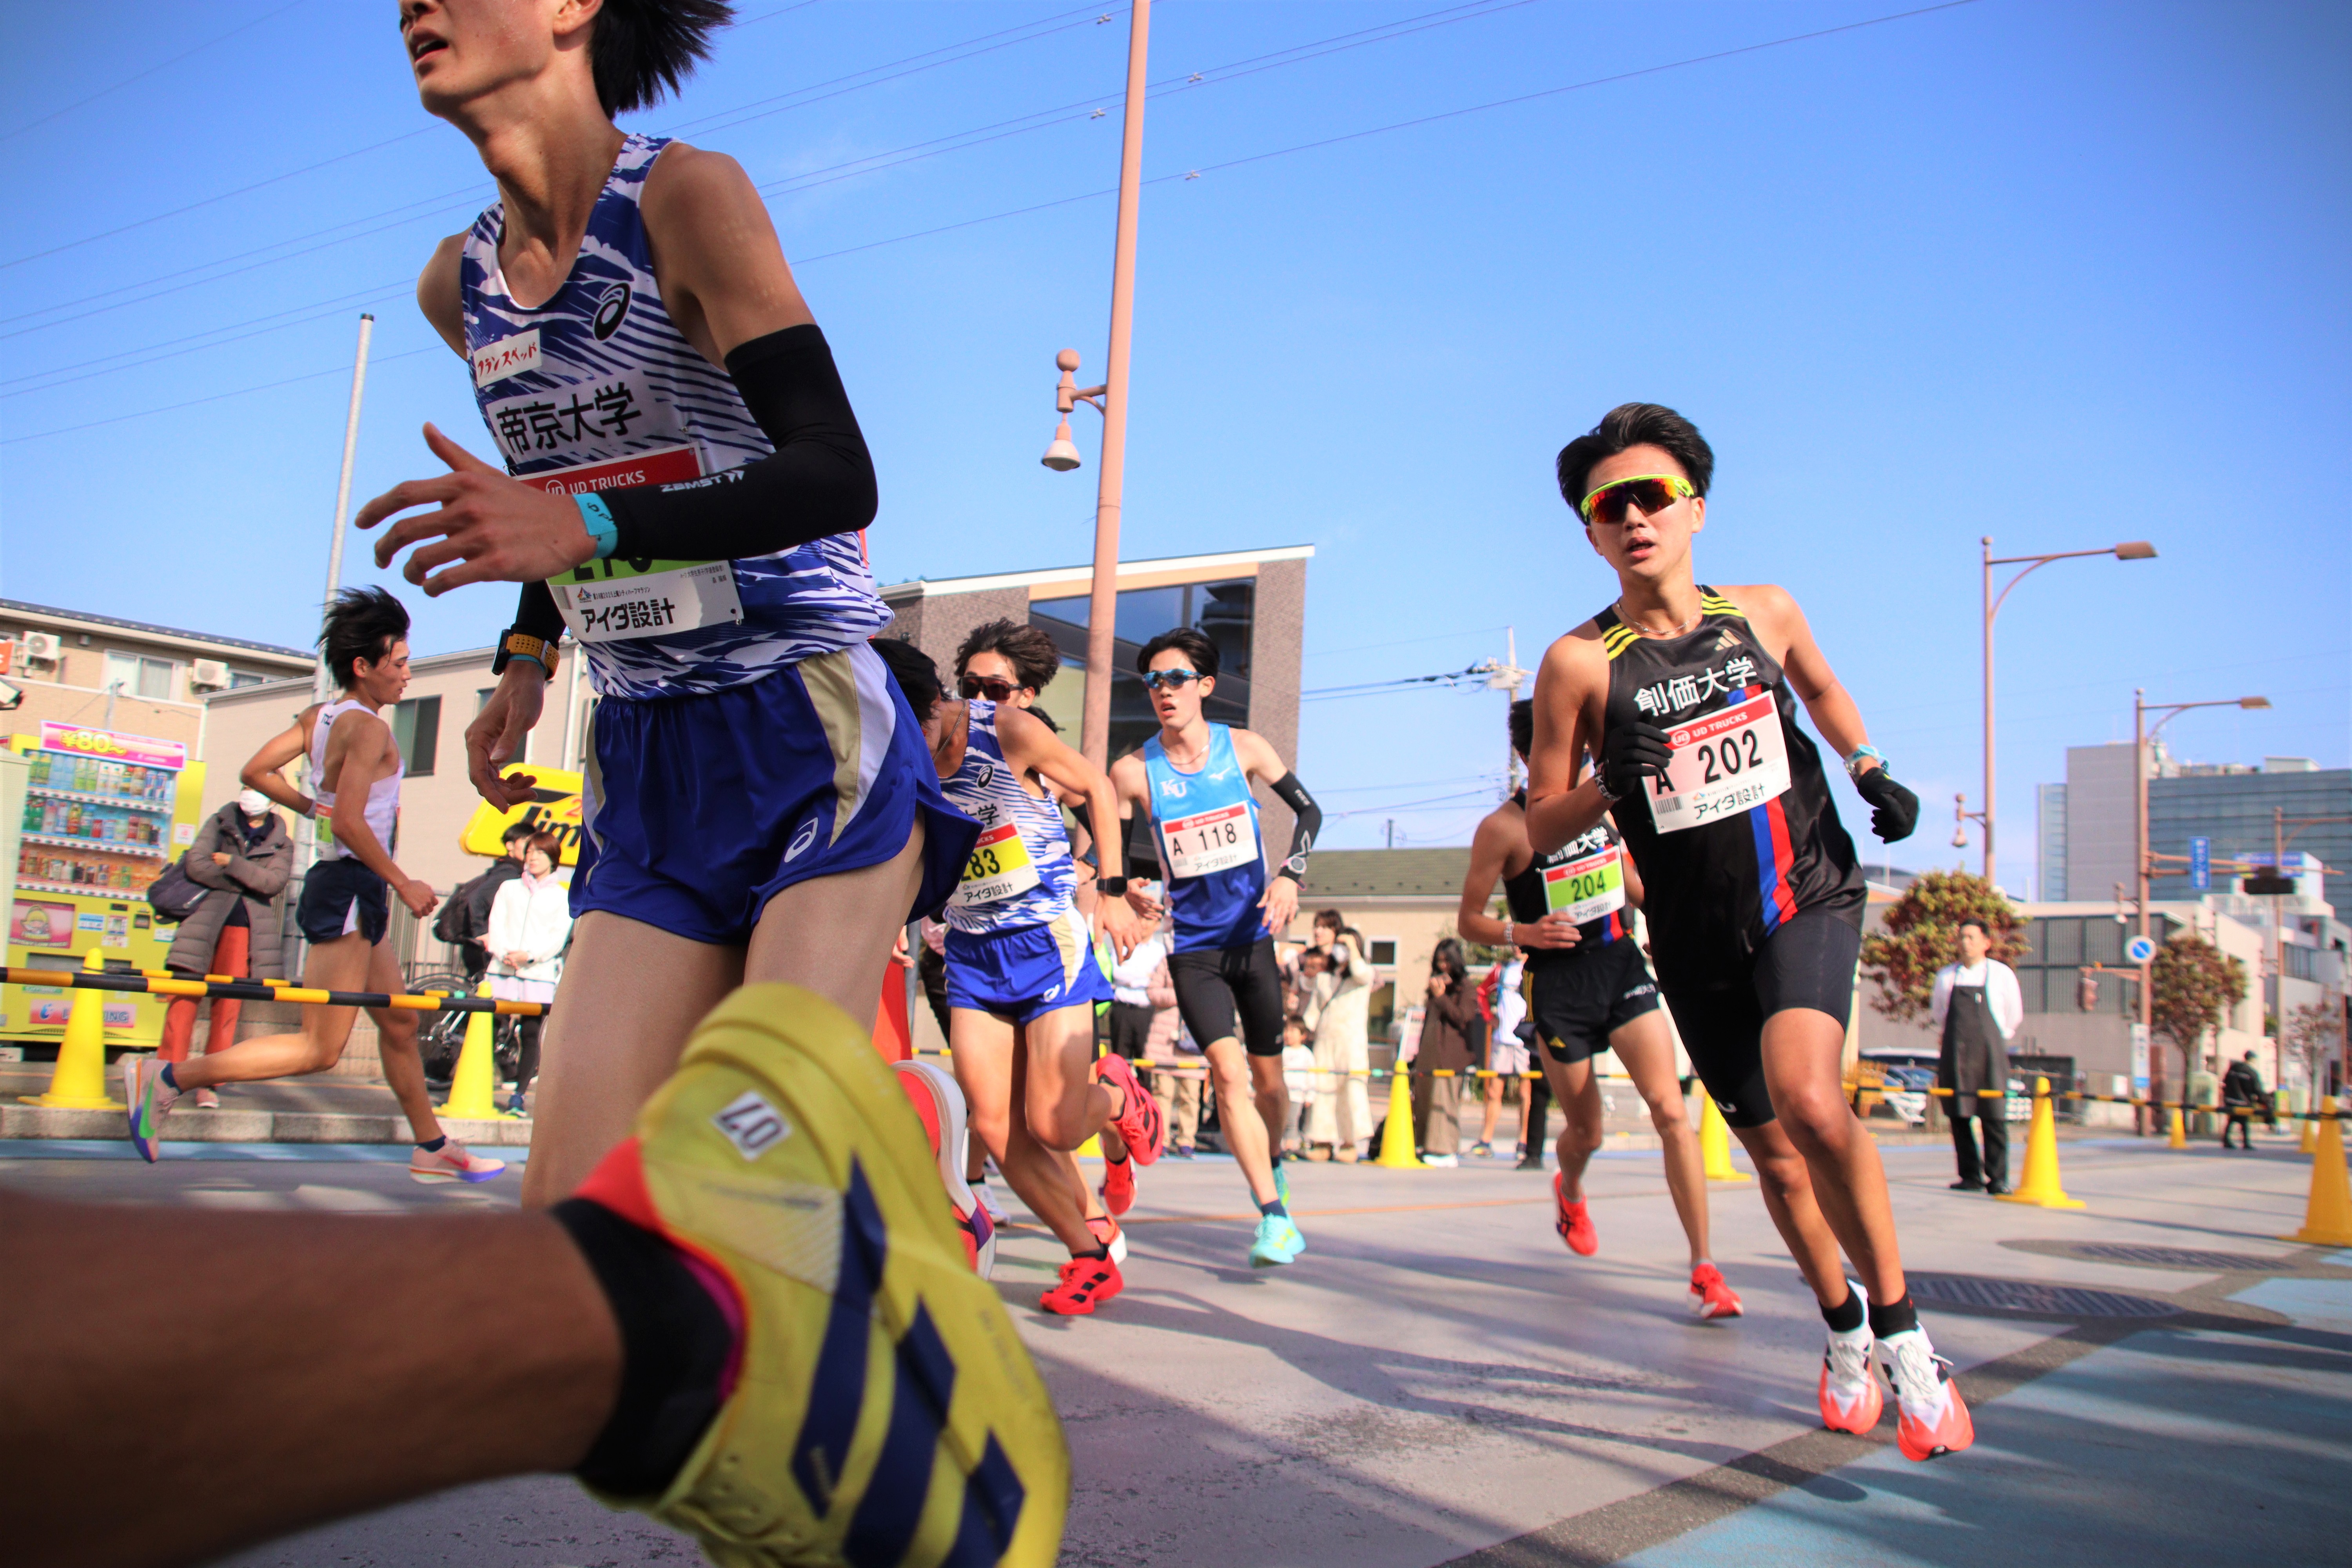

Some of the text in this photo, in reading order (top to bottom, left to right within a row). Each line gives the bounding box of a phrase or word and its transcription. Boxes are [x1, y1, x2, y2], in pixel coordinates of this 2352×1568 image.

[496, 382, 642, 455] 帝京大学
[569, 481, 587, 494] UD
[590, 470, 646, 492] TRUCKS
[581, 597, 675, 633] アイダ設計
[1633, 656, 1757, 716] 創価大学
[1692, 726, 1708, 737] UD
[1708, 712, 1748, 731] TRUCKS
[1656, 768, 1676, 795] A
[1698, 729, 1763, 784] 202
[1160, 779, 1187, 797] KU
[1694, 783, 1765, 819] アイダ設計
[1173, 837, 1183, 856] A
[1198, 823, 1236, 850] 118
[964, 882, 1013, 902] アイダ設計
[1572, 870, 1606, 901] 204
